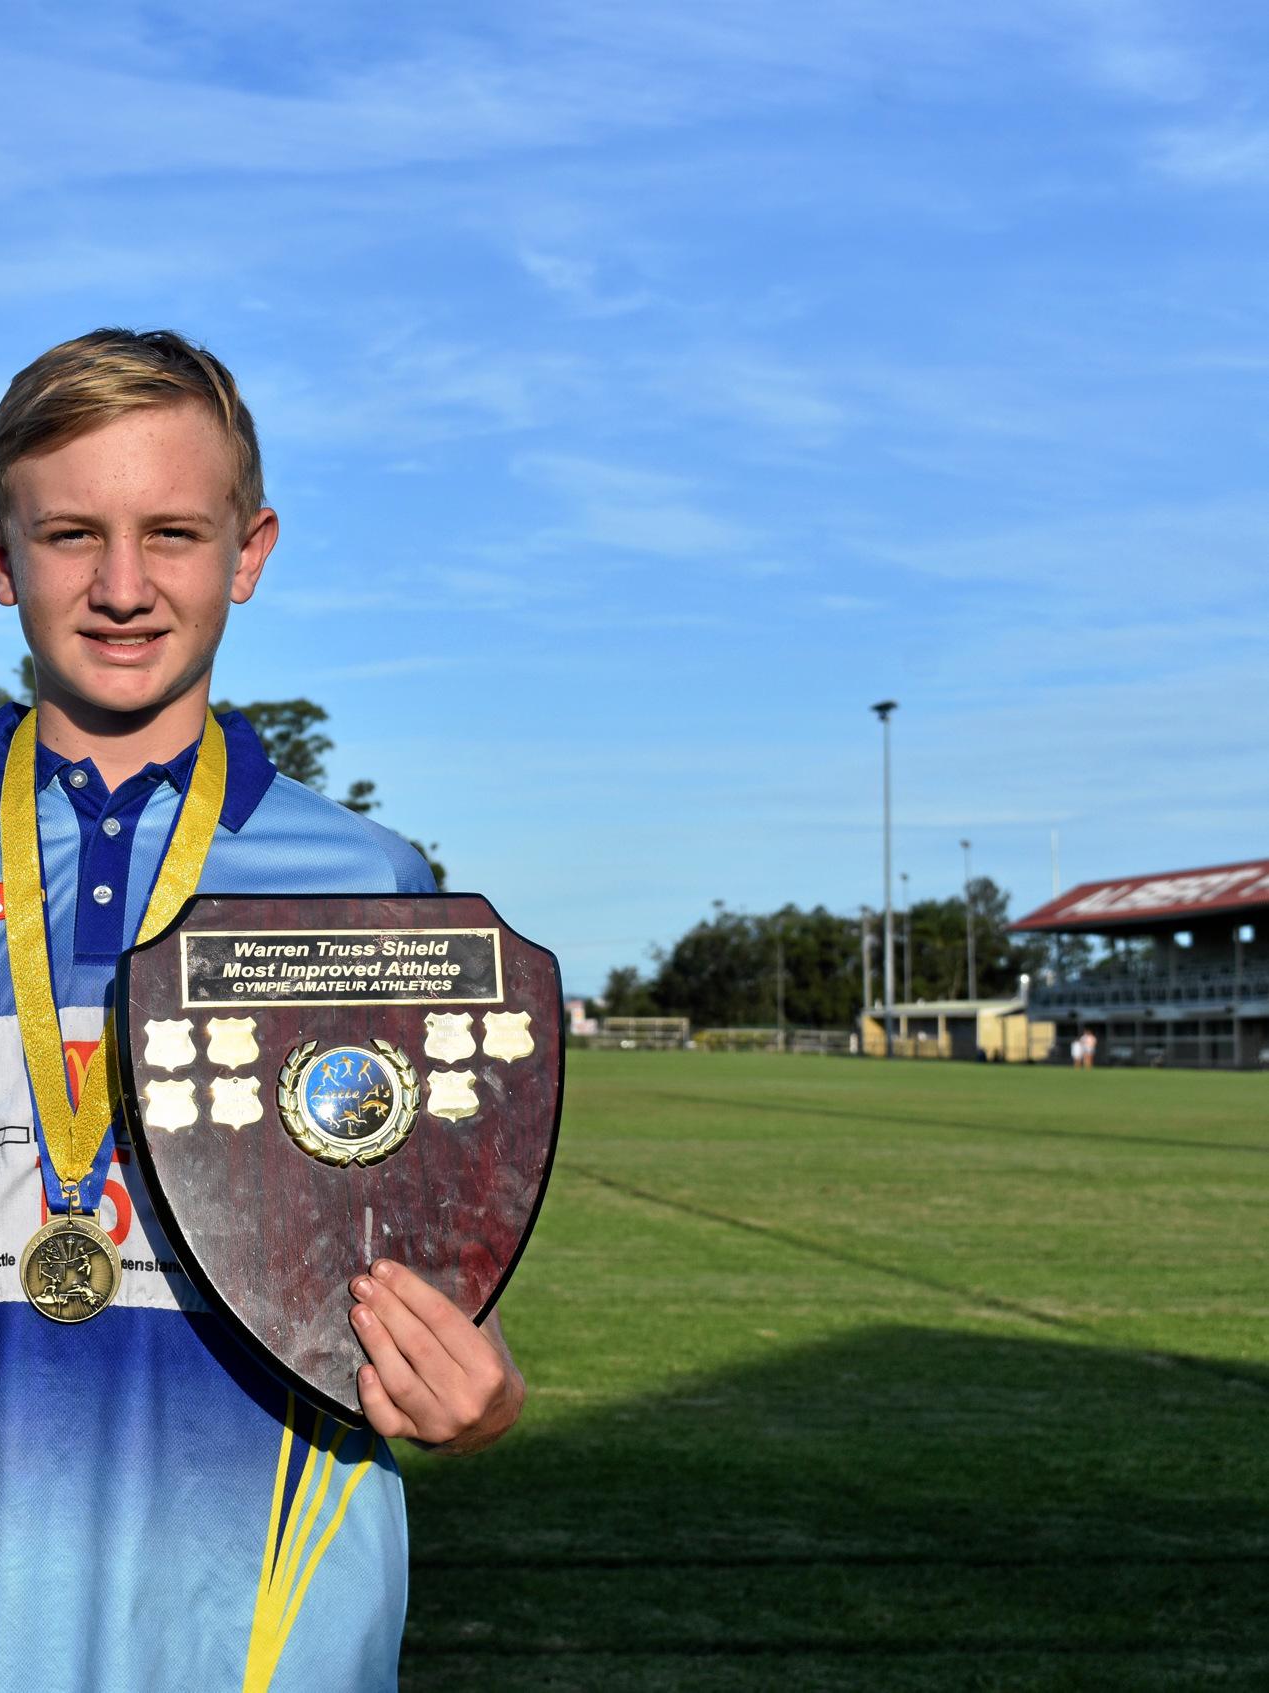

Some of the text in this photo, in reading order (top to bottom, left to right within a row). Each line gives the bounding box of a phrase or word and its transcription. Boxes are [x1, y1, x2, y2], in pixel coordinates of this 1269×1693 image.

[234, 940, 450, 957] Warren Truss Shield
[222, 959, 461, 980] Most Improved Athlete
[232, 979, 453, 992] GYMPIE AMATEUR ATHLETICS
